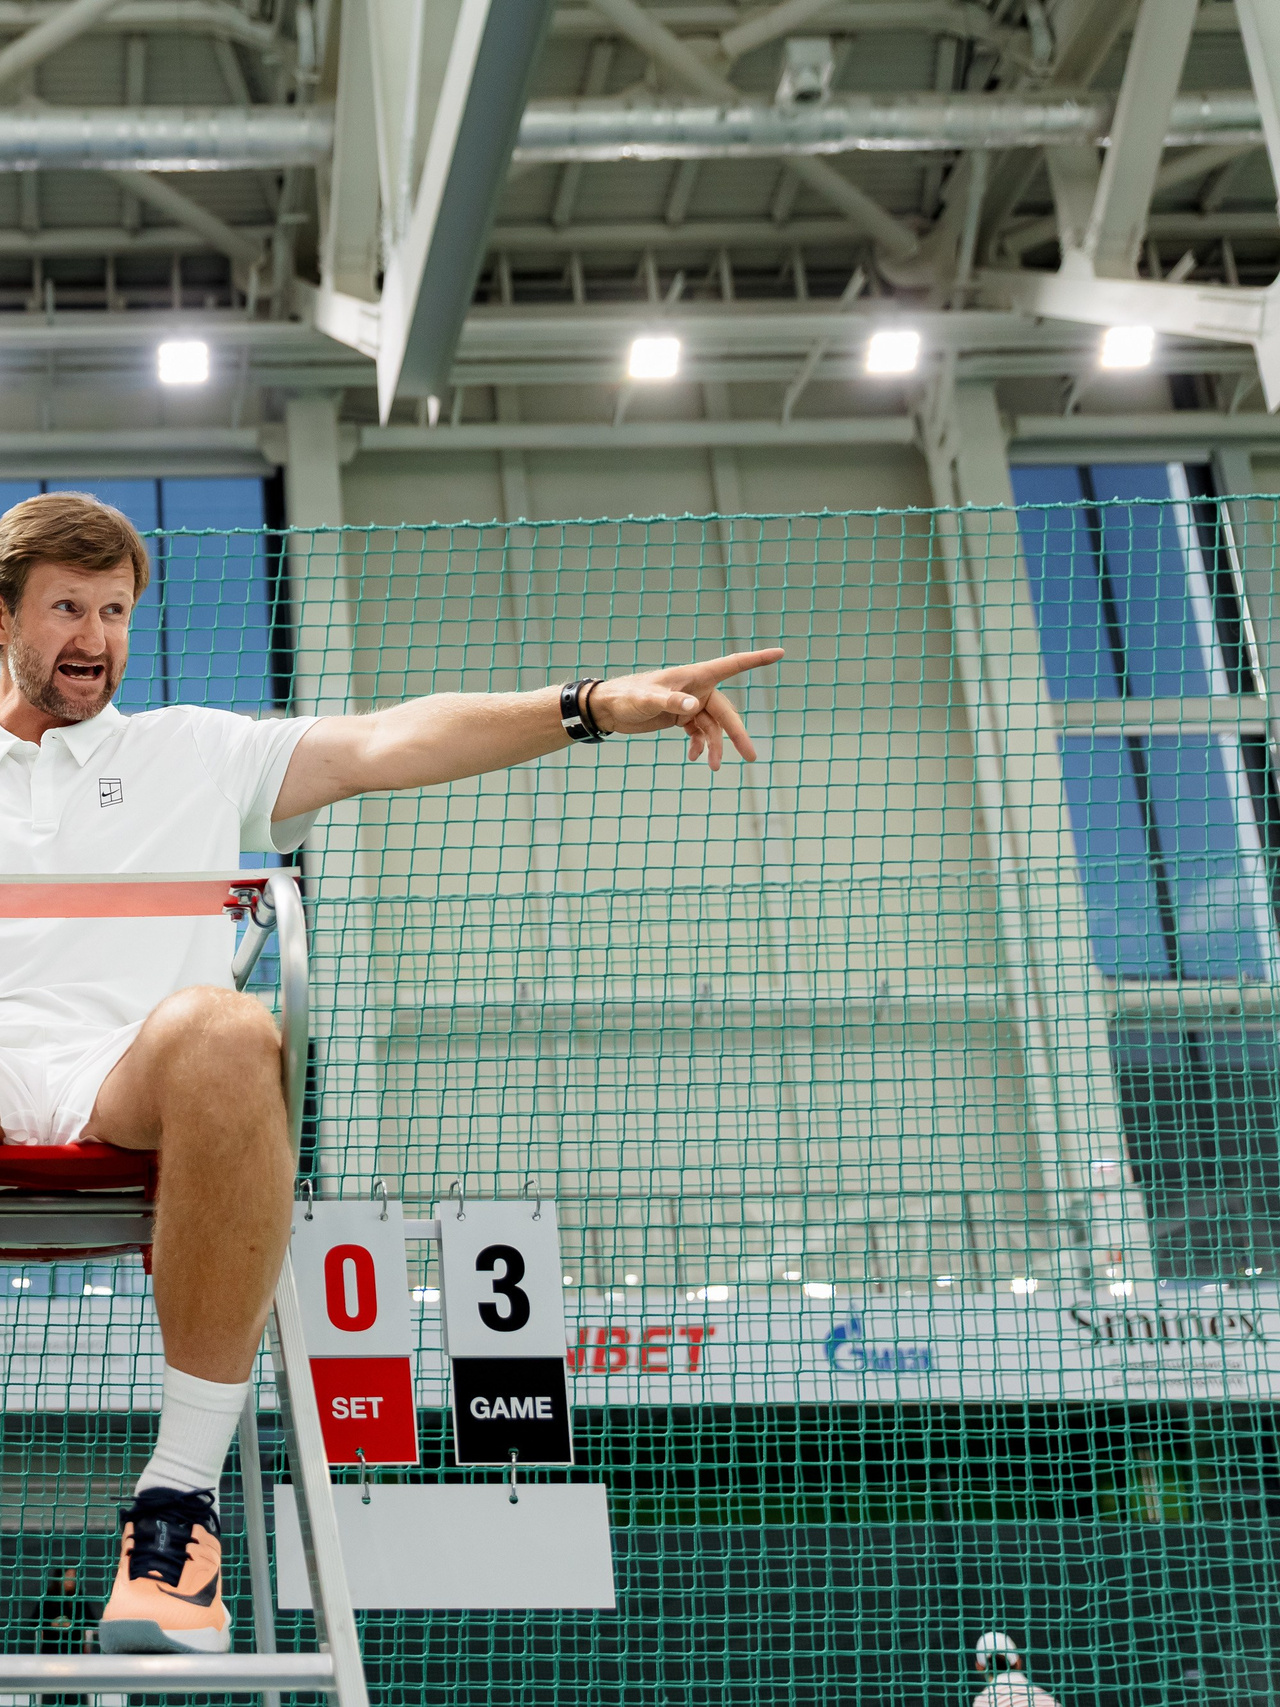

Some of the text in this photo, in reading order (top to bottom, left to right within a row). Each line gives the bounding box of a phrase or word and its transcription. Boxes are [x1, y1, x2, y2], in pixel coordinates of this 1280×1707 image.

[324, 1243, 377, 1332] 0
[475, 1244, 530, 1332] 3
[332, 1397, 383, 1419] SET
[470, 1397, 553, 1419] GAME
